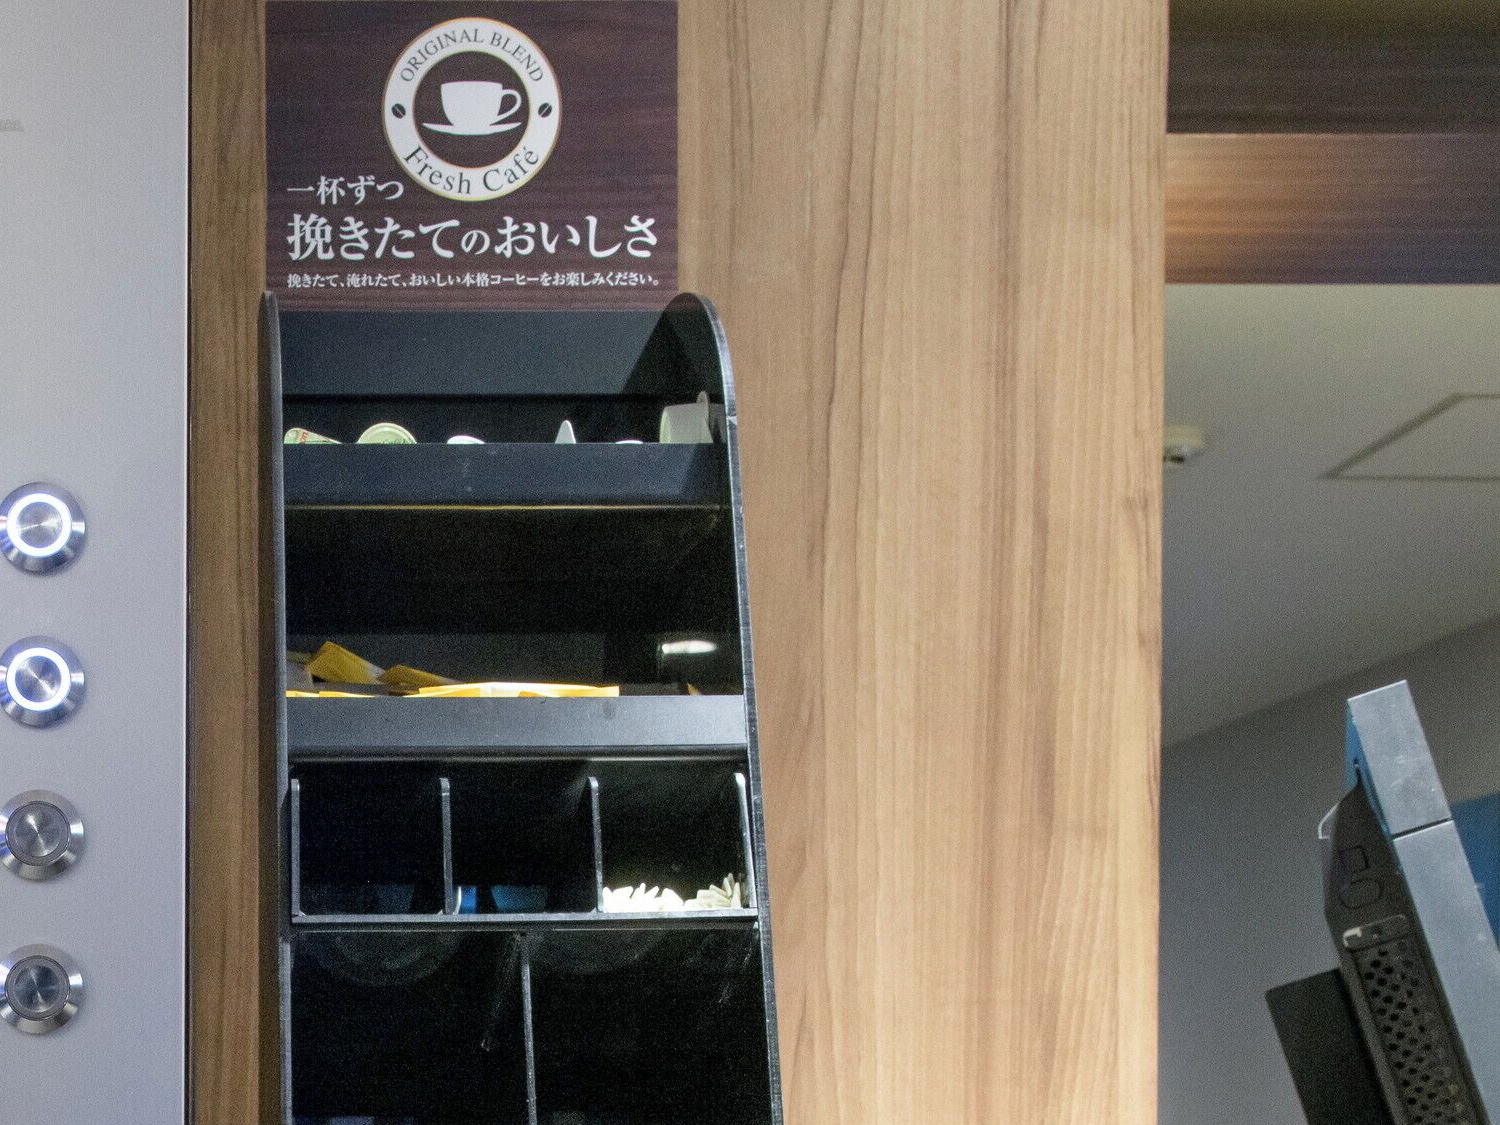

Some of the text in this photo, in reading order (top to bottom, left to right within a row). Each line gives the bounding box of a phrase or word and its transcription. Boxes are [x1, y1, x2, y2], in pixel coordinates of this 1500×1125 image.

[400, 28, 544, 83] ORIGINAL BLEND
[287, 175, 404, 205] 一杯ずつ
[404, 145, 540, 195] Fresh Café
[287, 213, 658, 261] 挽きたてのおいしさ
